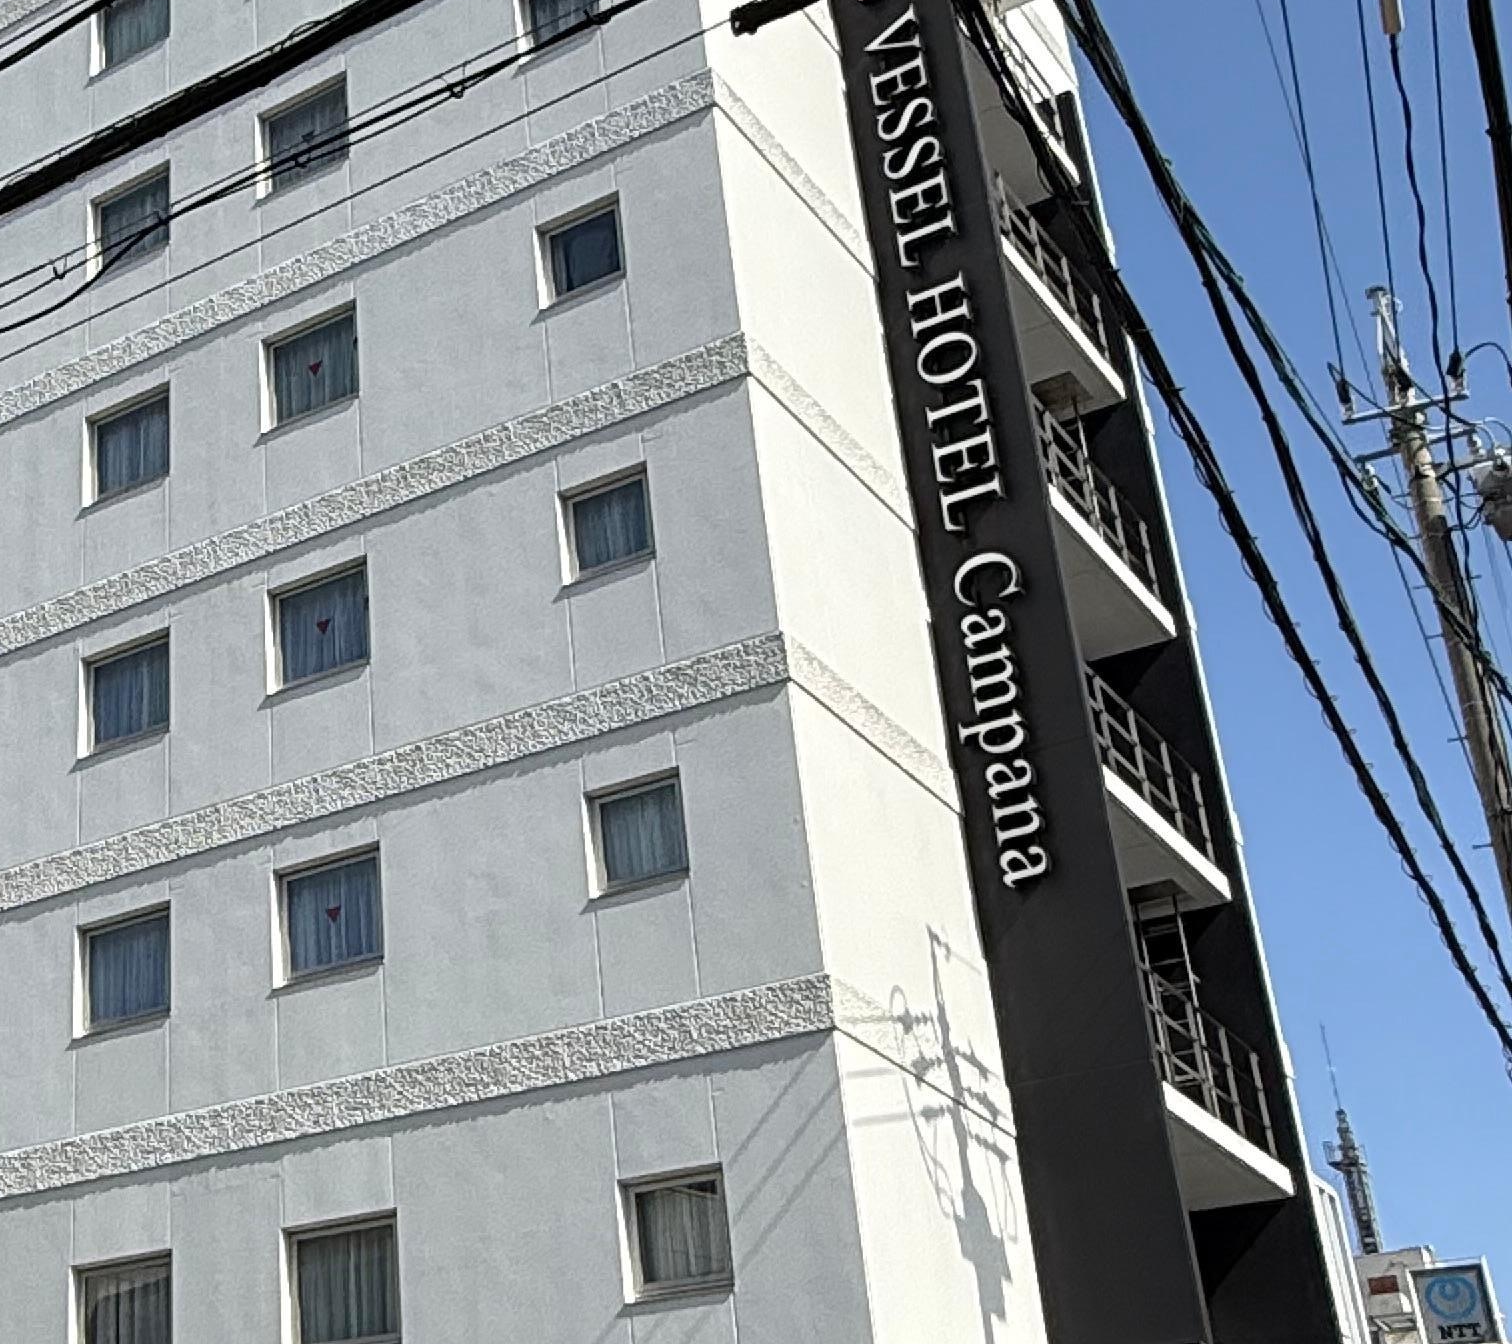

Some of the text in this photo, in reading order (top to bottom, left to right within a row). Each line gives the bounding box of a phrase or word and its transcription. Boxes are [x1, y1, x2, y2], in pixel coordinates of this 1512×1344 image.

[864, 3, 1050, 889] VESSEL HOTEL Campana
[1438, 1322, 1482, 1340] NTT
